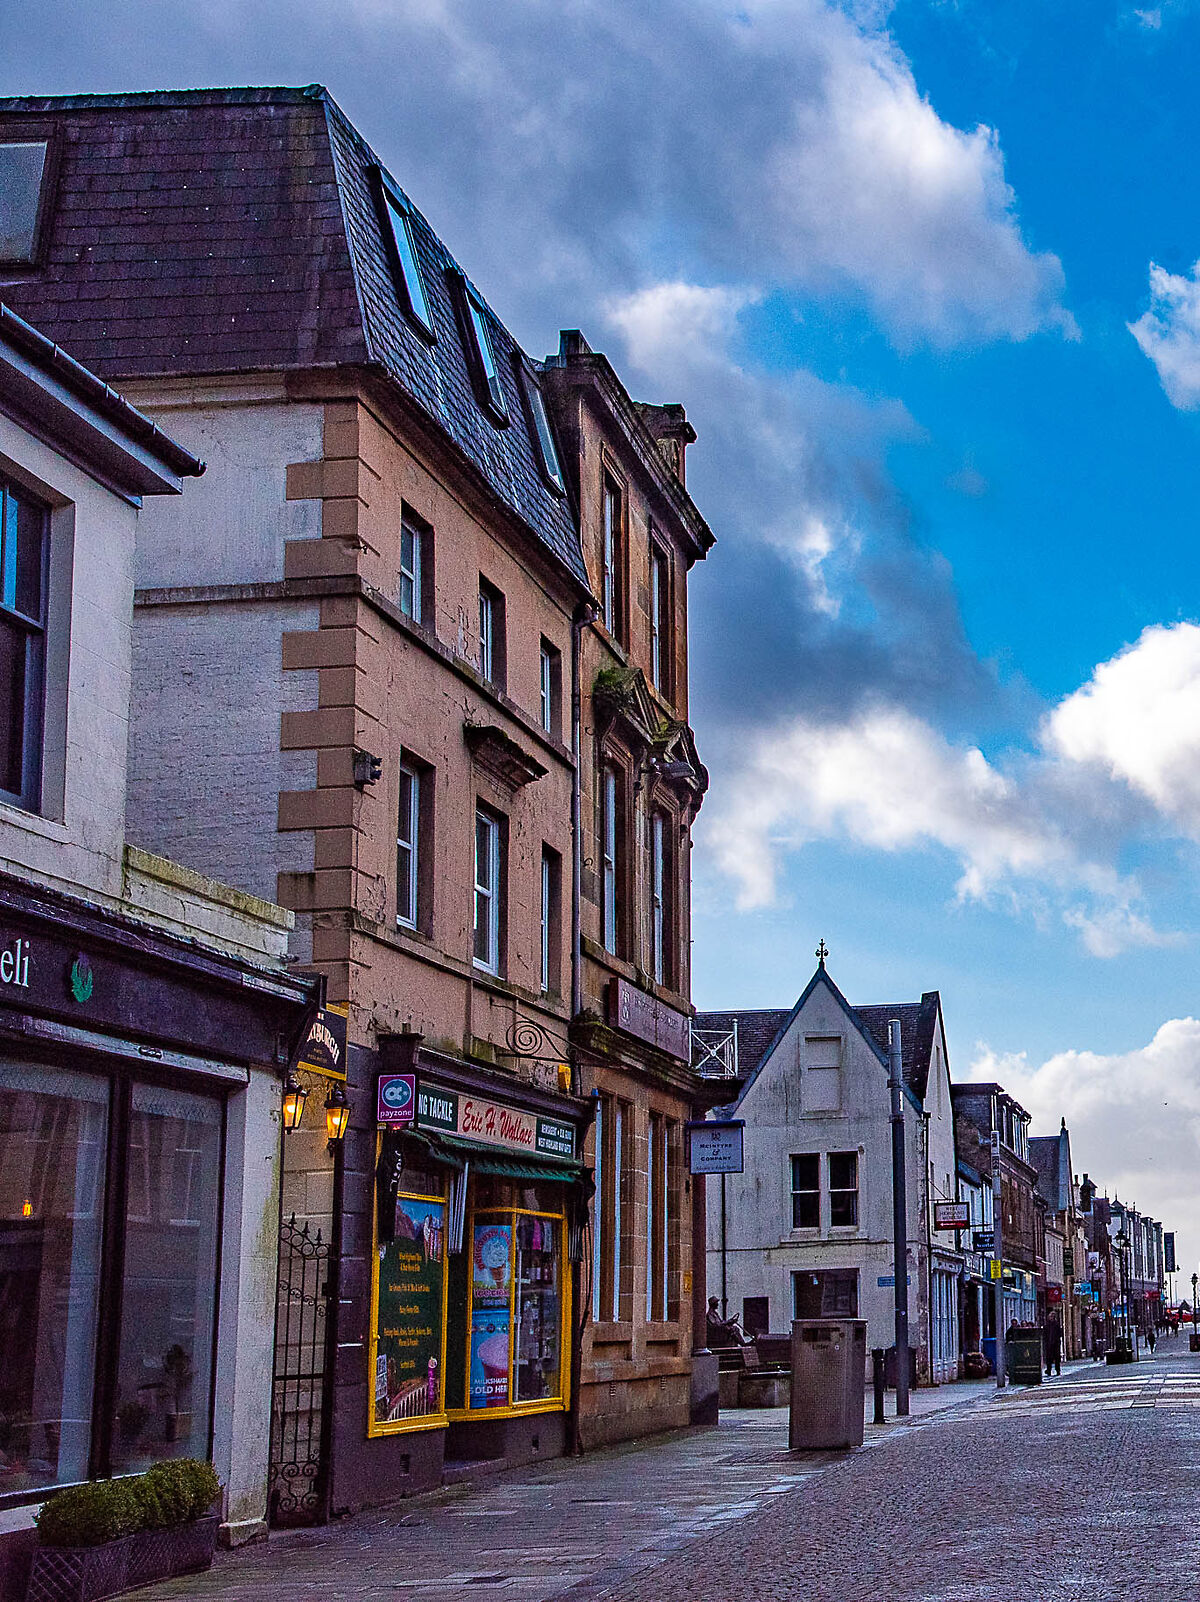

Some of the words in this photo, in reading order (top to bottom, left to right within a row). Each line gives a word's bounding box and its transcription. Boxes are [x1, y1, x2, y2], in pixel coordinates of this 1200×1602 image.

[380, 1110, 412, 1119] payzone
[429, 1096, 453, 1122] TACKLE
[462, 1101, 483, 1133] Eric
[485, 1107, 496, 1136] H.
[500, 1110, 534, 1145] Wallace
[469, 1386, 493, 1394] SOLD
